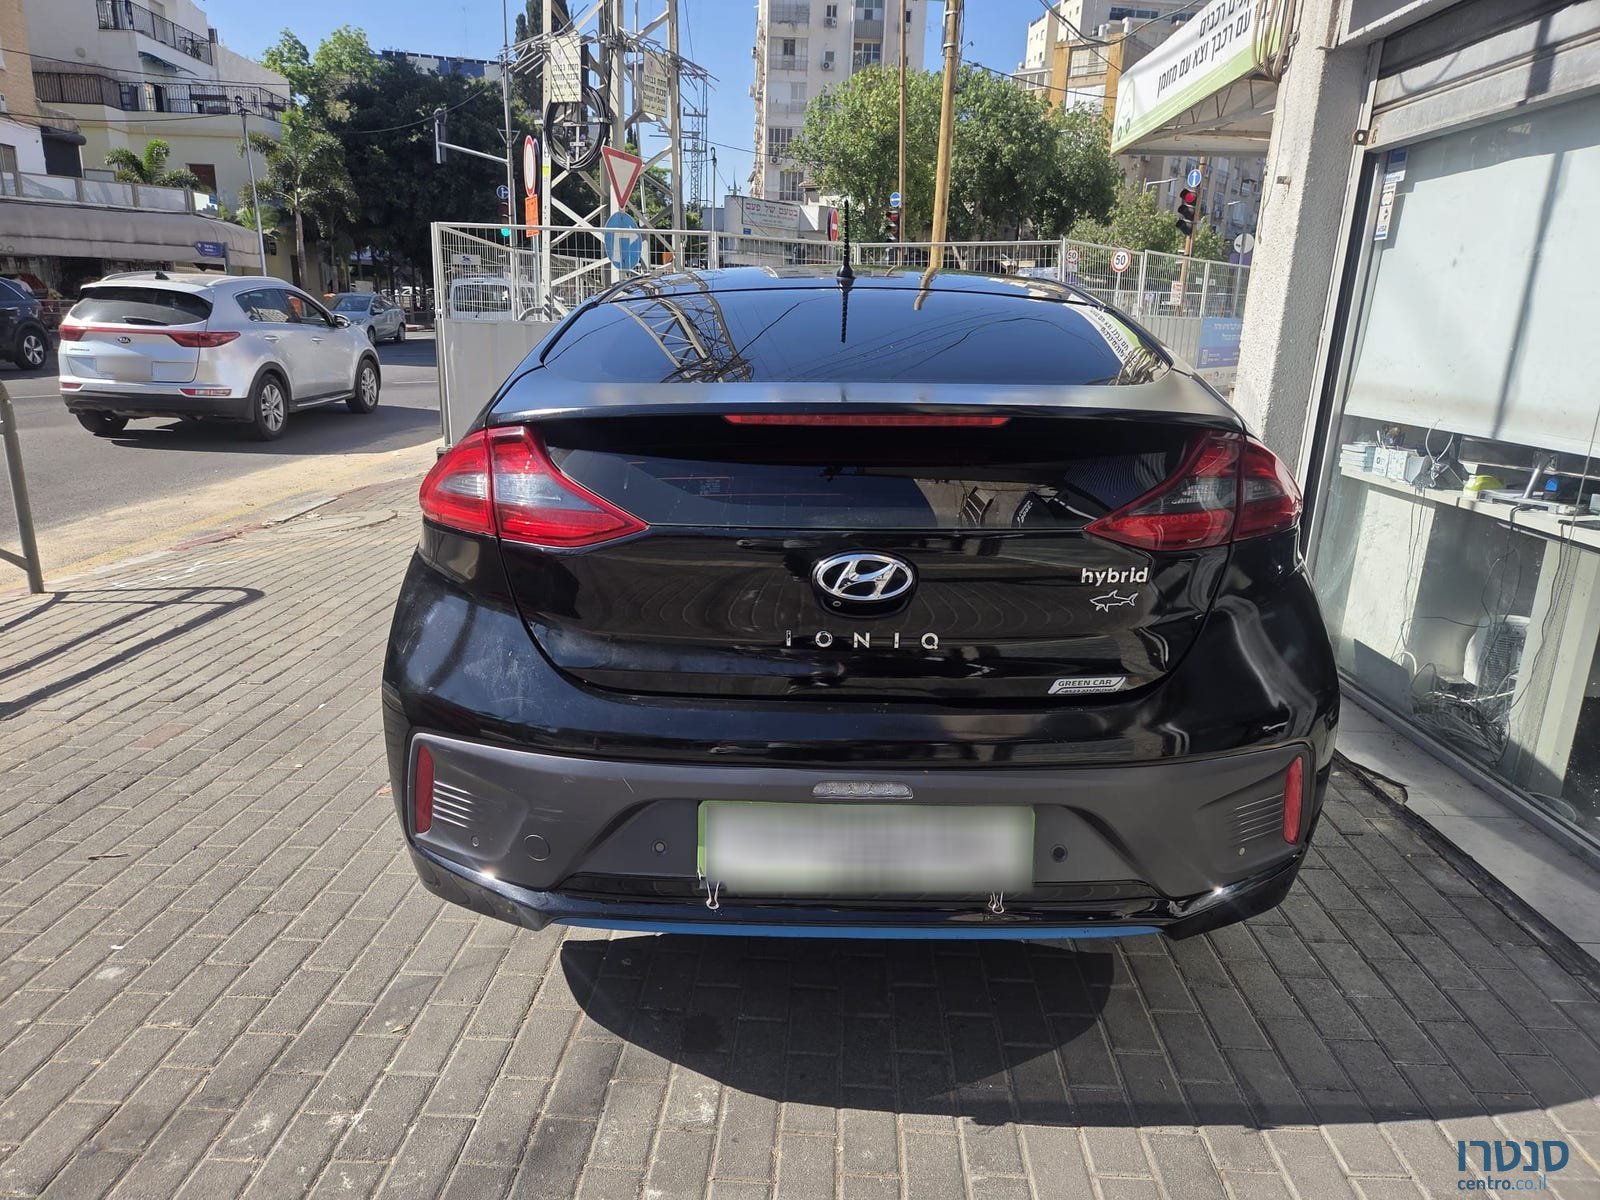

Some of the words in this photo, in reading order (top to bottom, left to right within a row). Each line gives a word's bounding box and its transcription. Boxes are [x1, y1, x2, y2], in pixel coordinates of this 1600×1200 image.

[1199, 2, 1226, 38] רכבים
[1236, 8, 1252, 38] עם
[1211, 23, 1233, 62] רכבך
[1192, 41, 1209, 69] וצא
[1179, 53, 1192, 79] עם
[1157, 63, 1177, 99] מזומן
[745, 202, 761, 212] פעם
[764, 203, 776, 214] של
[778, 207, 798, 217] בטעם
[1067, 252, 1077, 260] 50
[1115, 254, 1126, 266] 50
[1081, 567, 1149, 587] hybrid
[786, 629, 939, 650] IONIQ
